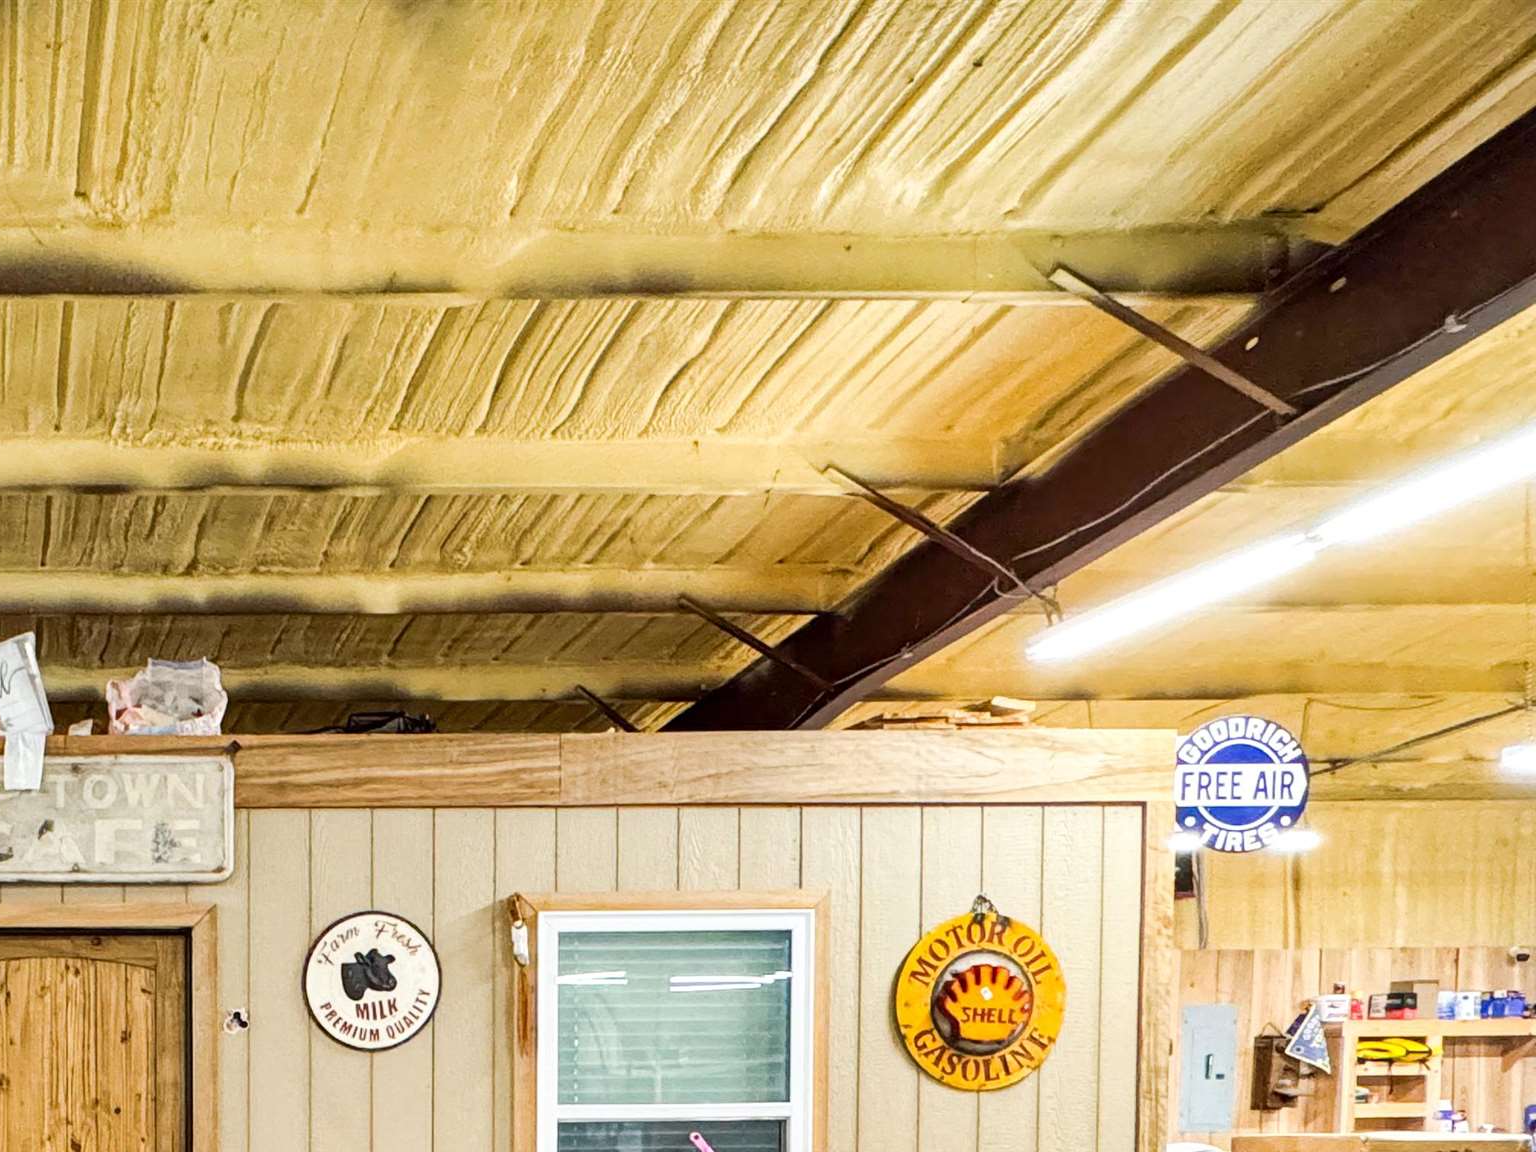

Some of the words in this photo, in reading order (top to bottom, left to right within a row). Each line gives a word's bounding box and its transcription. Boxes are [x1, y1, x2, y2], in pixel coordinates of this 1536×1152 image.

[1177, 716, 1303, 765] GOODRICH
[1180, 770, 1243, 801] FREE
[1252, 770, 1295, 800] AIR
[1200, 821, 1281, 852] TIRES
[316, 924, 361, 966] Farm
[374, 919, 423, 957] Fresh
[907, 920, 1010, 988] MOTOR
[1012, 934, 1053, 985] OIL
[320, 1002, 381, 1042] PREMIUM
[386, 988, 432, 1040] QUALITY
[354, 998, 399, 1021] MILK
[961, 1007, 1018, 1025] SHELL
[913, 1027, 1053, 1082] GASOLINE
